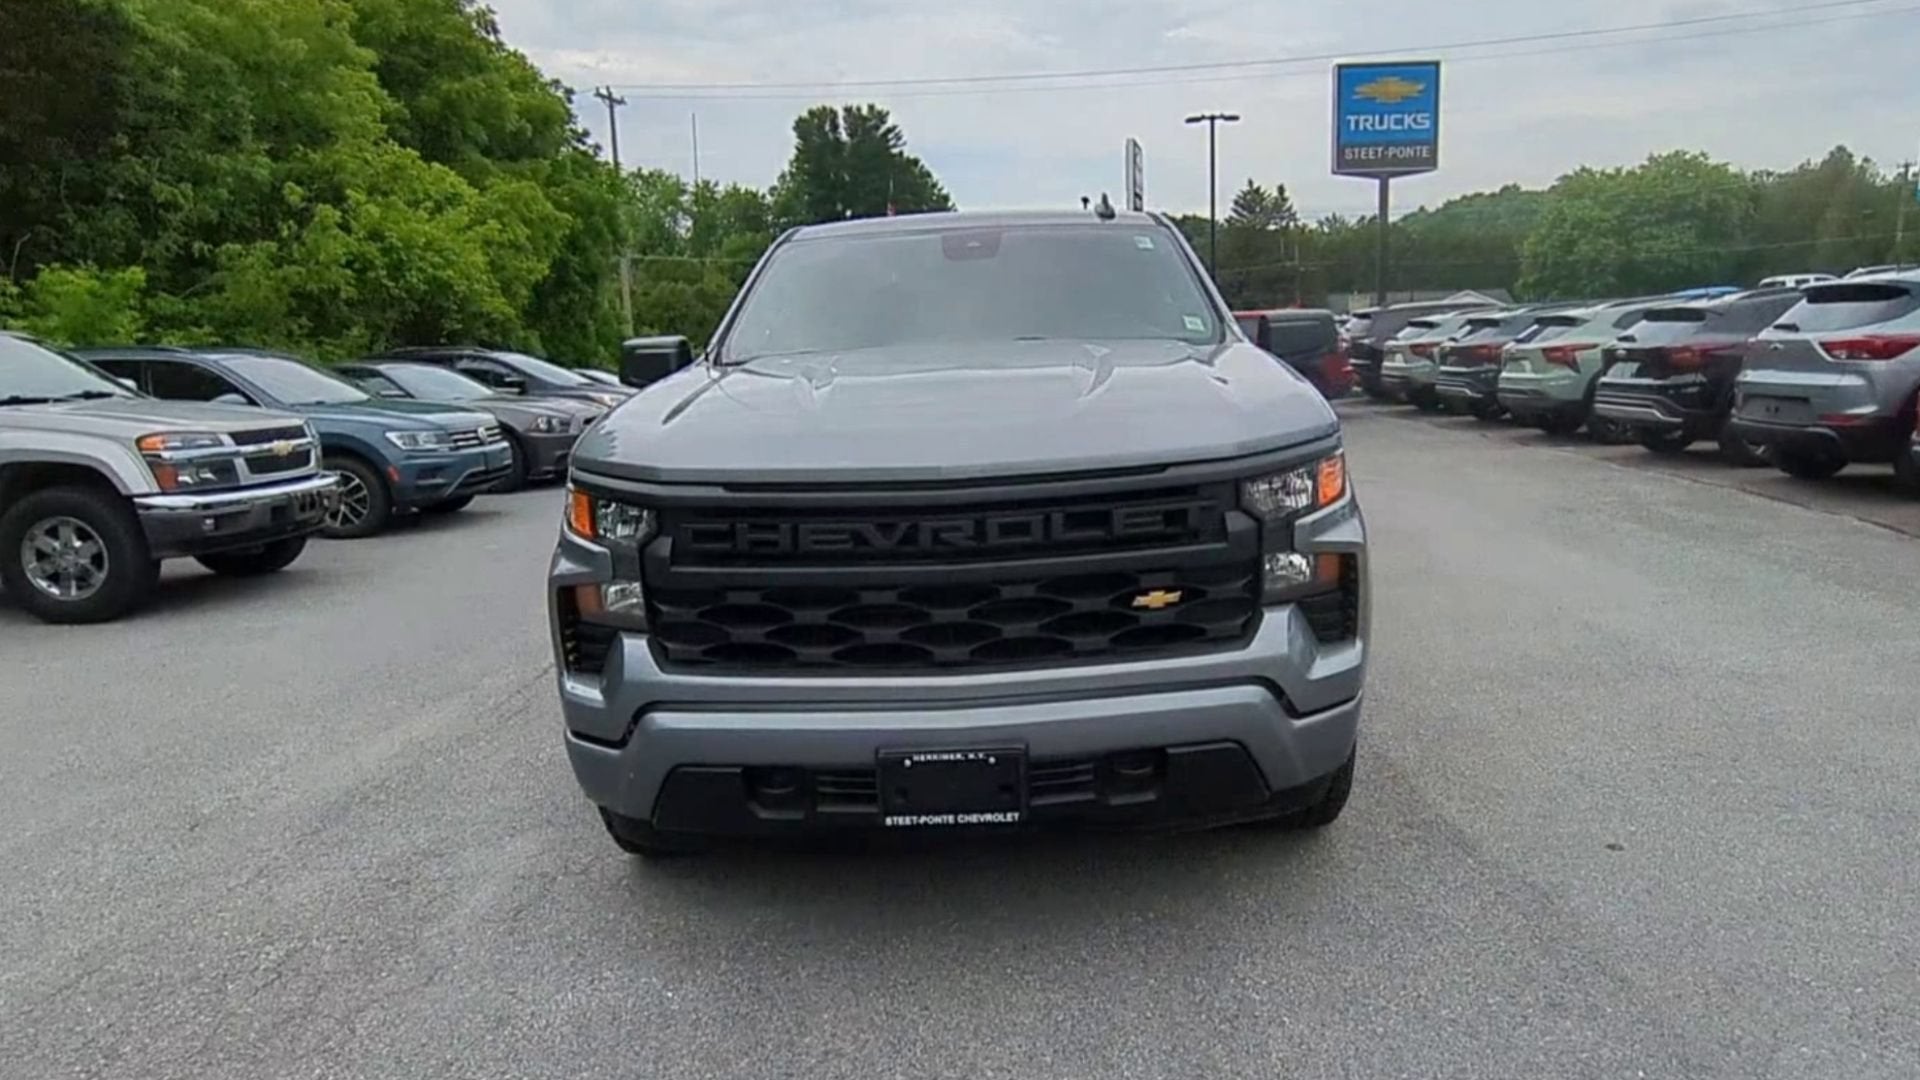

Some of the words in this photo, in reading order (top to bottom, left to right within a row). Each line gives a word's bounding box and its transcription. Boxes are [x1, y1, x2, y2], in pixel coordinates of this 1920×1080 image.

[1346, 112, 1431, 131] TRUCKS
[1345, 145, 1431, 160] STEET-PONTE
[681, 499, 1219, 552] CHEVROLET
[885, 814, 955, 826] STEET-PONTE
[957, 812, 1020, 824] CHEVROLET
